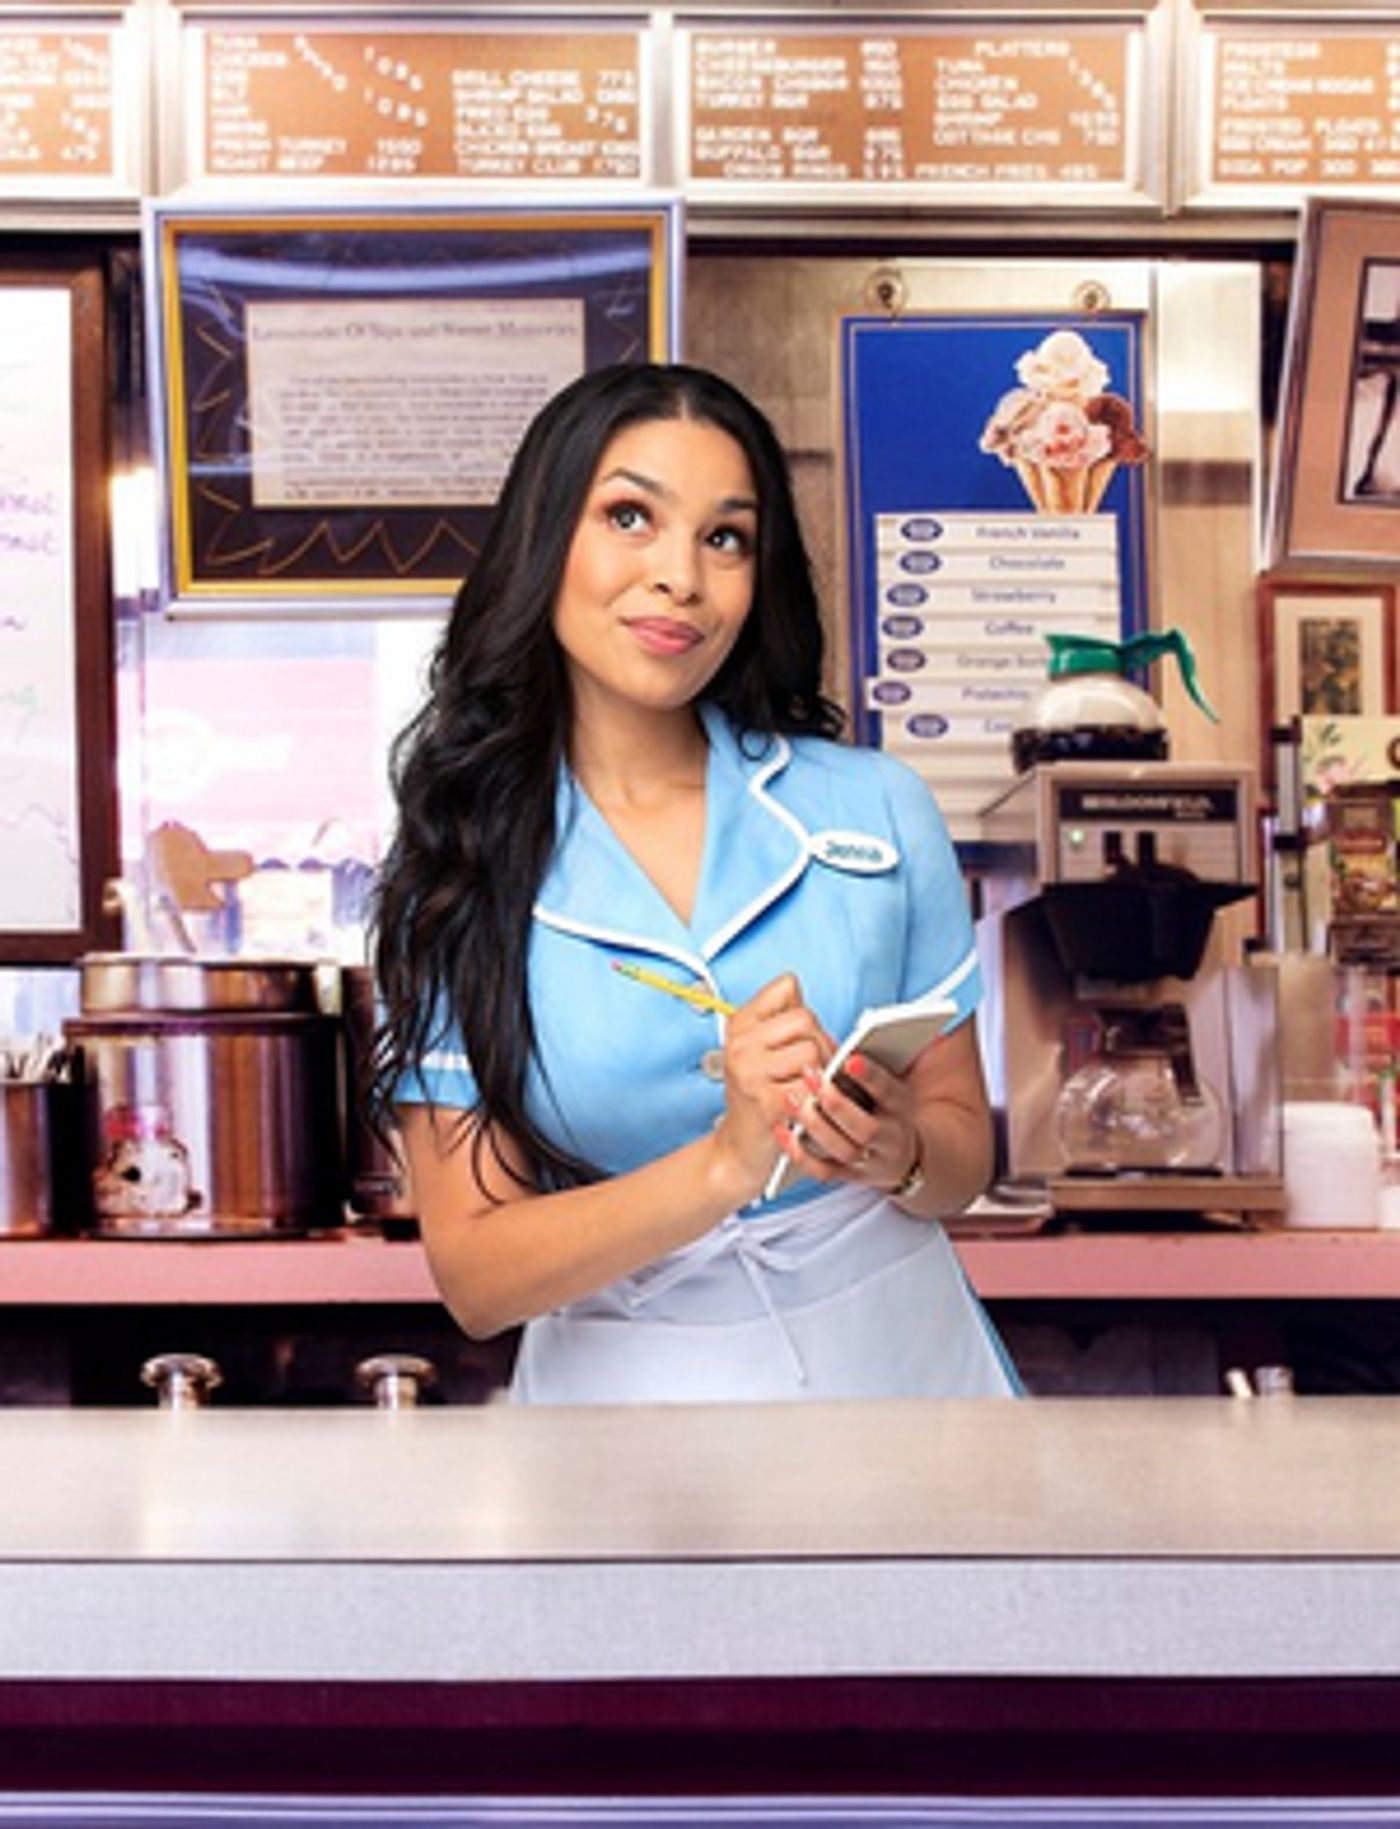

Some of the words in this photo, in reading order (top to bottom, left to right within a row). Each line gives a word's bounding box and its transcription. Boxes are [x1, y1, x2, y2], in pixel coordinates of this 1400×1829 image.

[988, 556, 1066, 572] Chocolate
[971, 588, 1058, 605] Strawberry
[984, 620, 1035, 637] Coffee
[956, 654, 1012, 671] Orange
